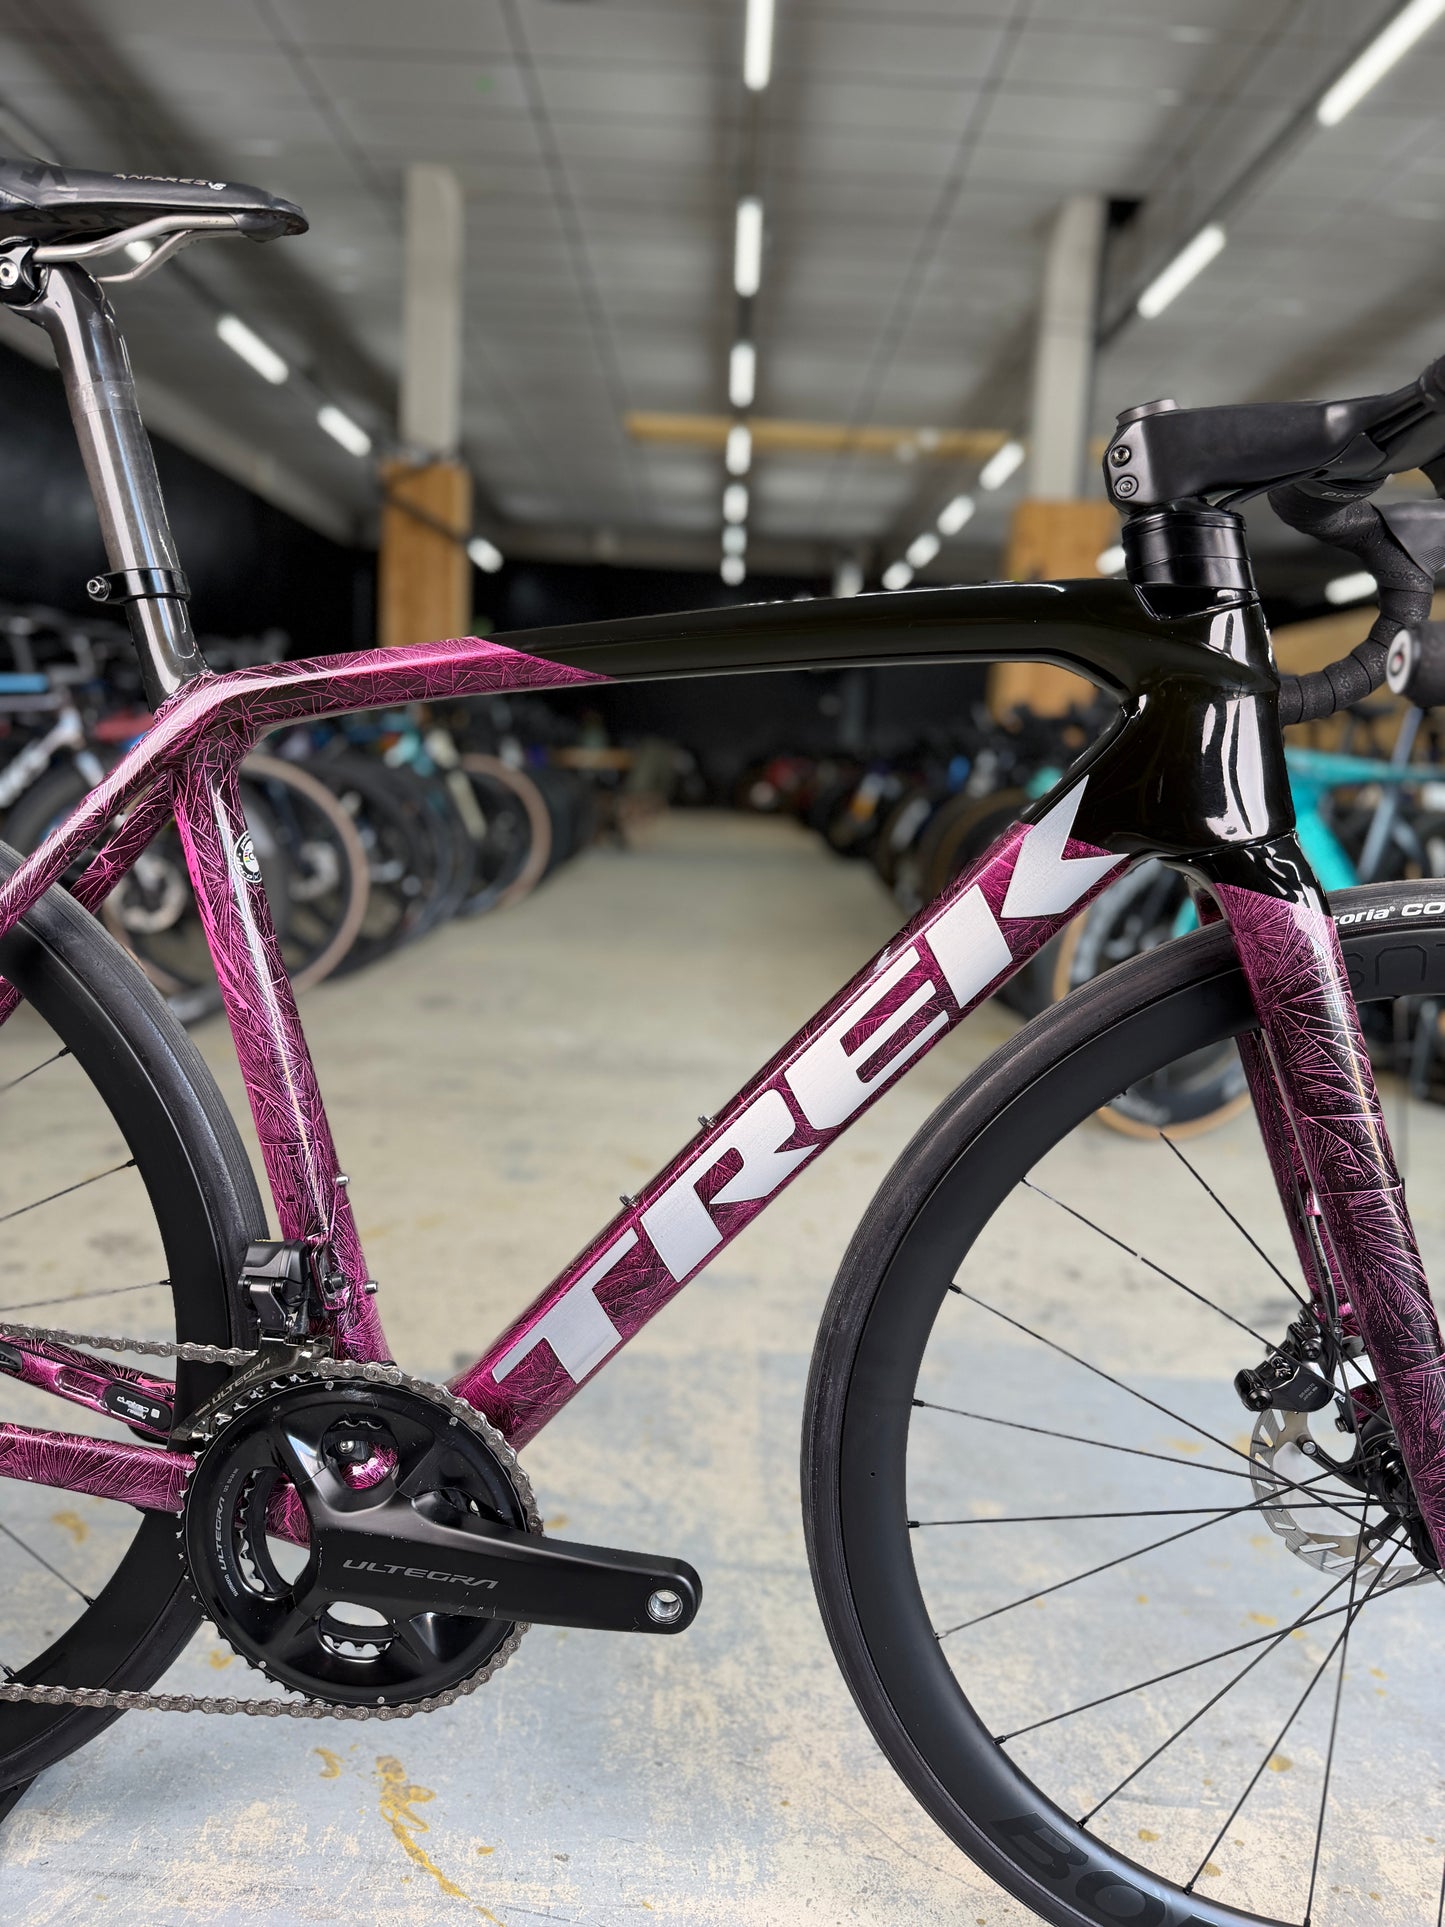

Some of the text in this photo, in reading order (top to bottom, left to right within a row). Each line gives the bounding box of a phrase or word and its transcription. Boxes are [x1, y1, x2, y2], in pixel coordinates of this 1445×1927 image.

[492, 774, 1130, 1384] TREK
[211, 1357, 271, 1405] ULTEGRA
[214, 1496, 227, 1571] ULTEGRA
[342, 1558, 500, 1590] ULTEGRA
